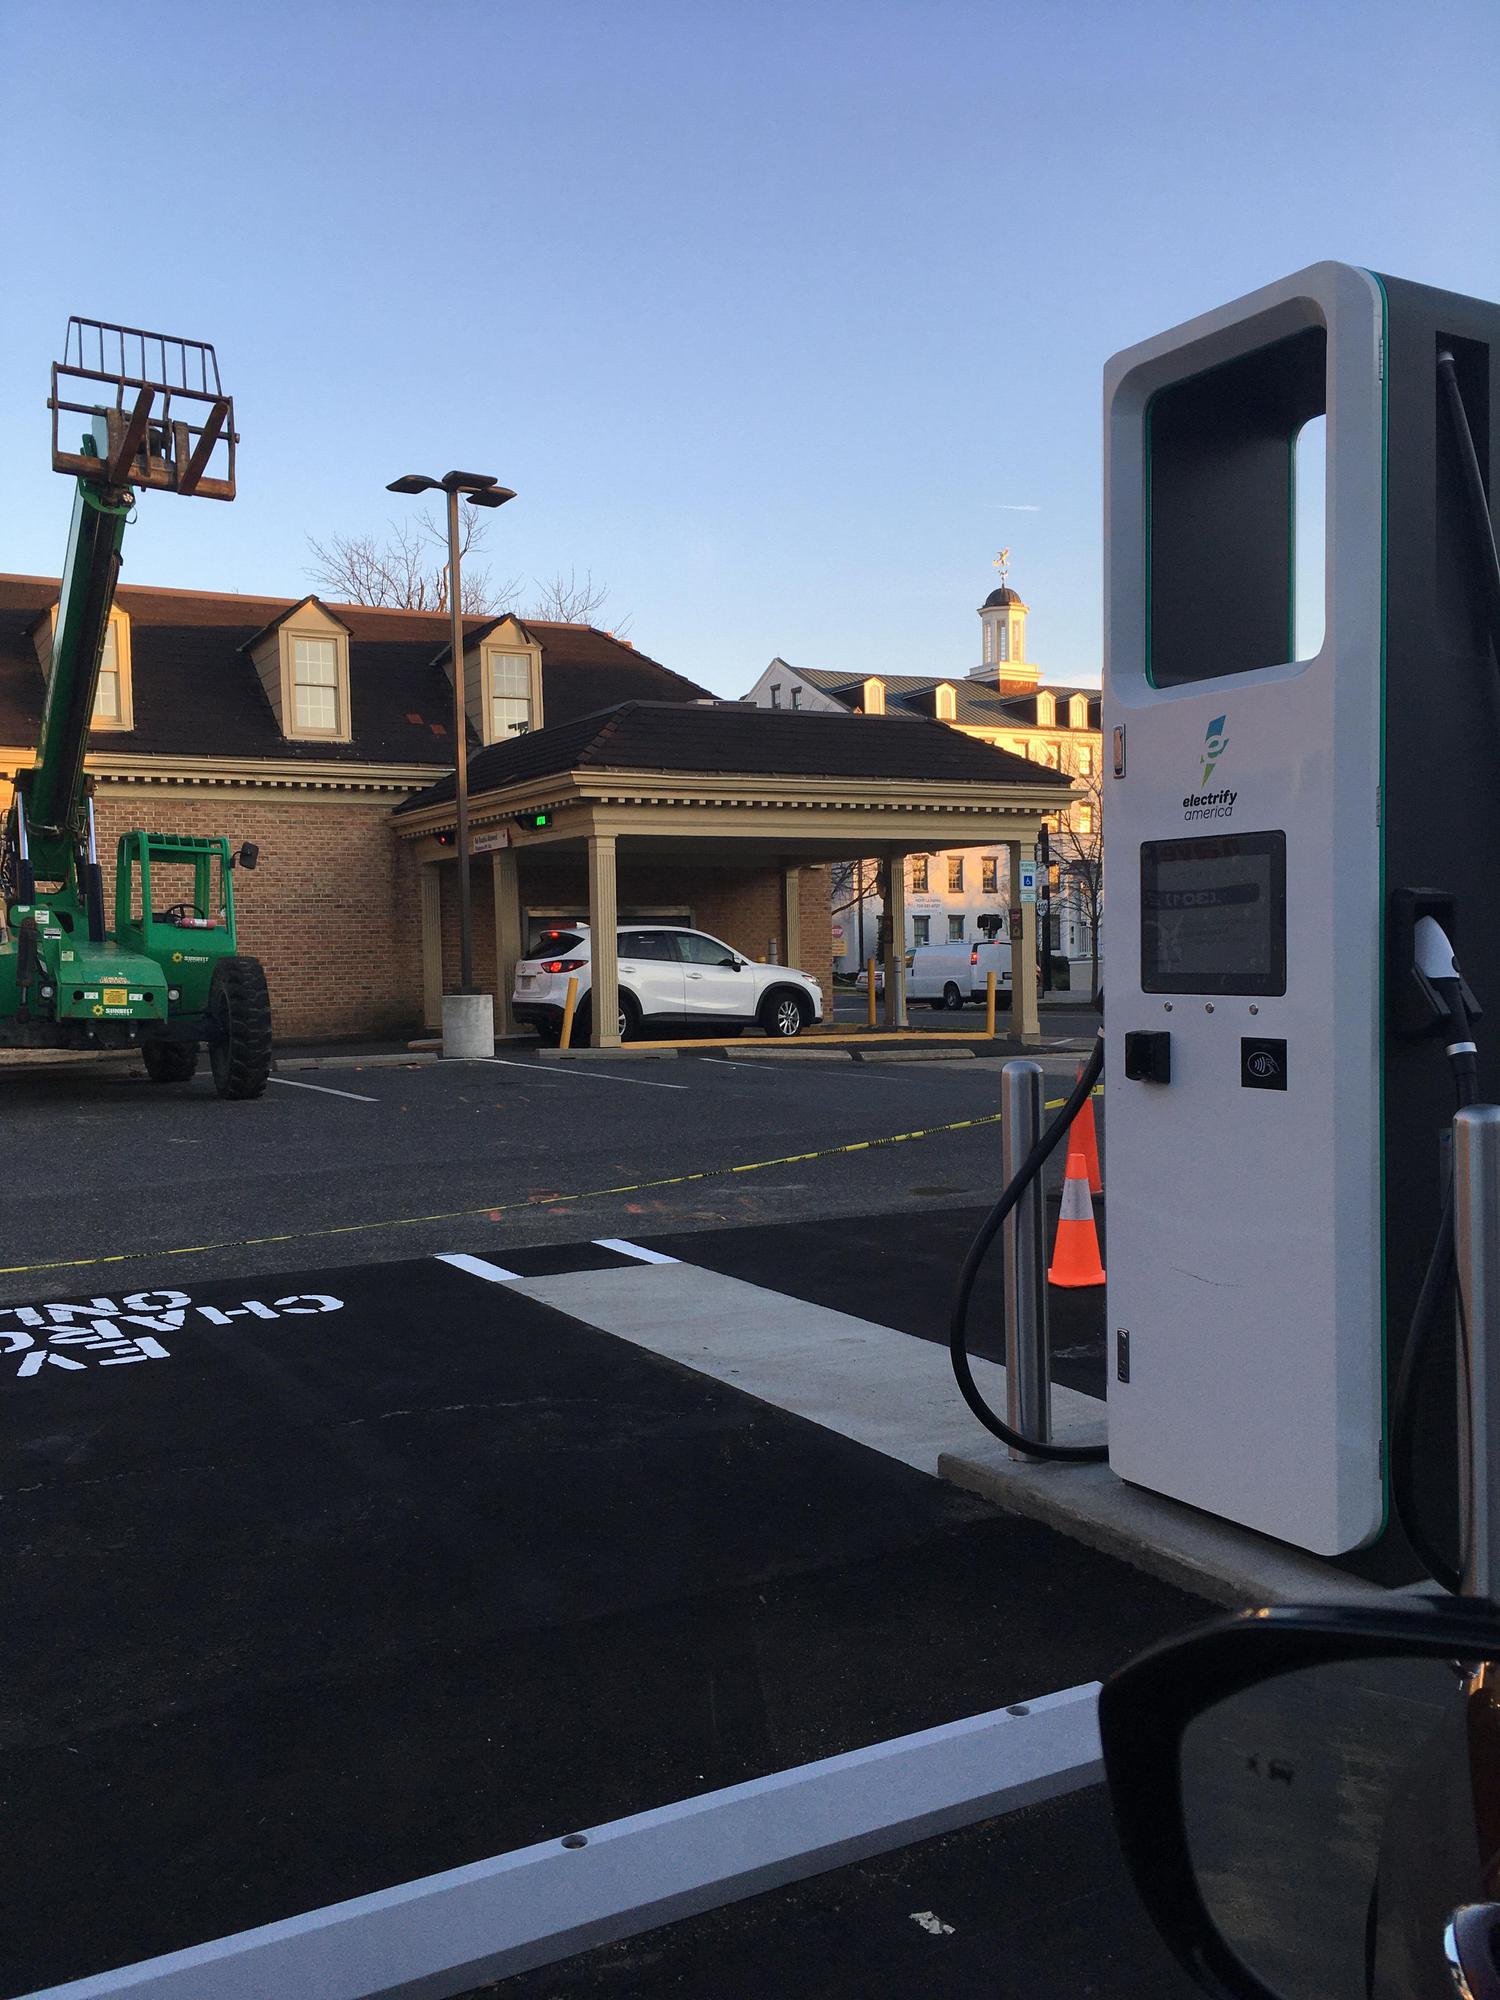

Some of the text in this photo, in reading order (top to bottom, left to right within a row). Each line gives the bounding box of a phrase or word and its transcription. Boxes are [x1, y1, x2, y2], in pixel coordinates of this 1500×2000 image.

[1183, 790, 1237, 808] electrify
[1184, 806, 1233, 821] america
[17, 1337, 170, 1377] EV
